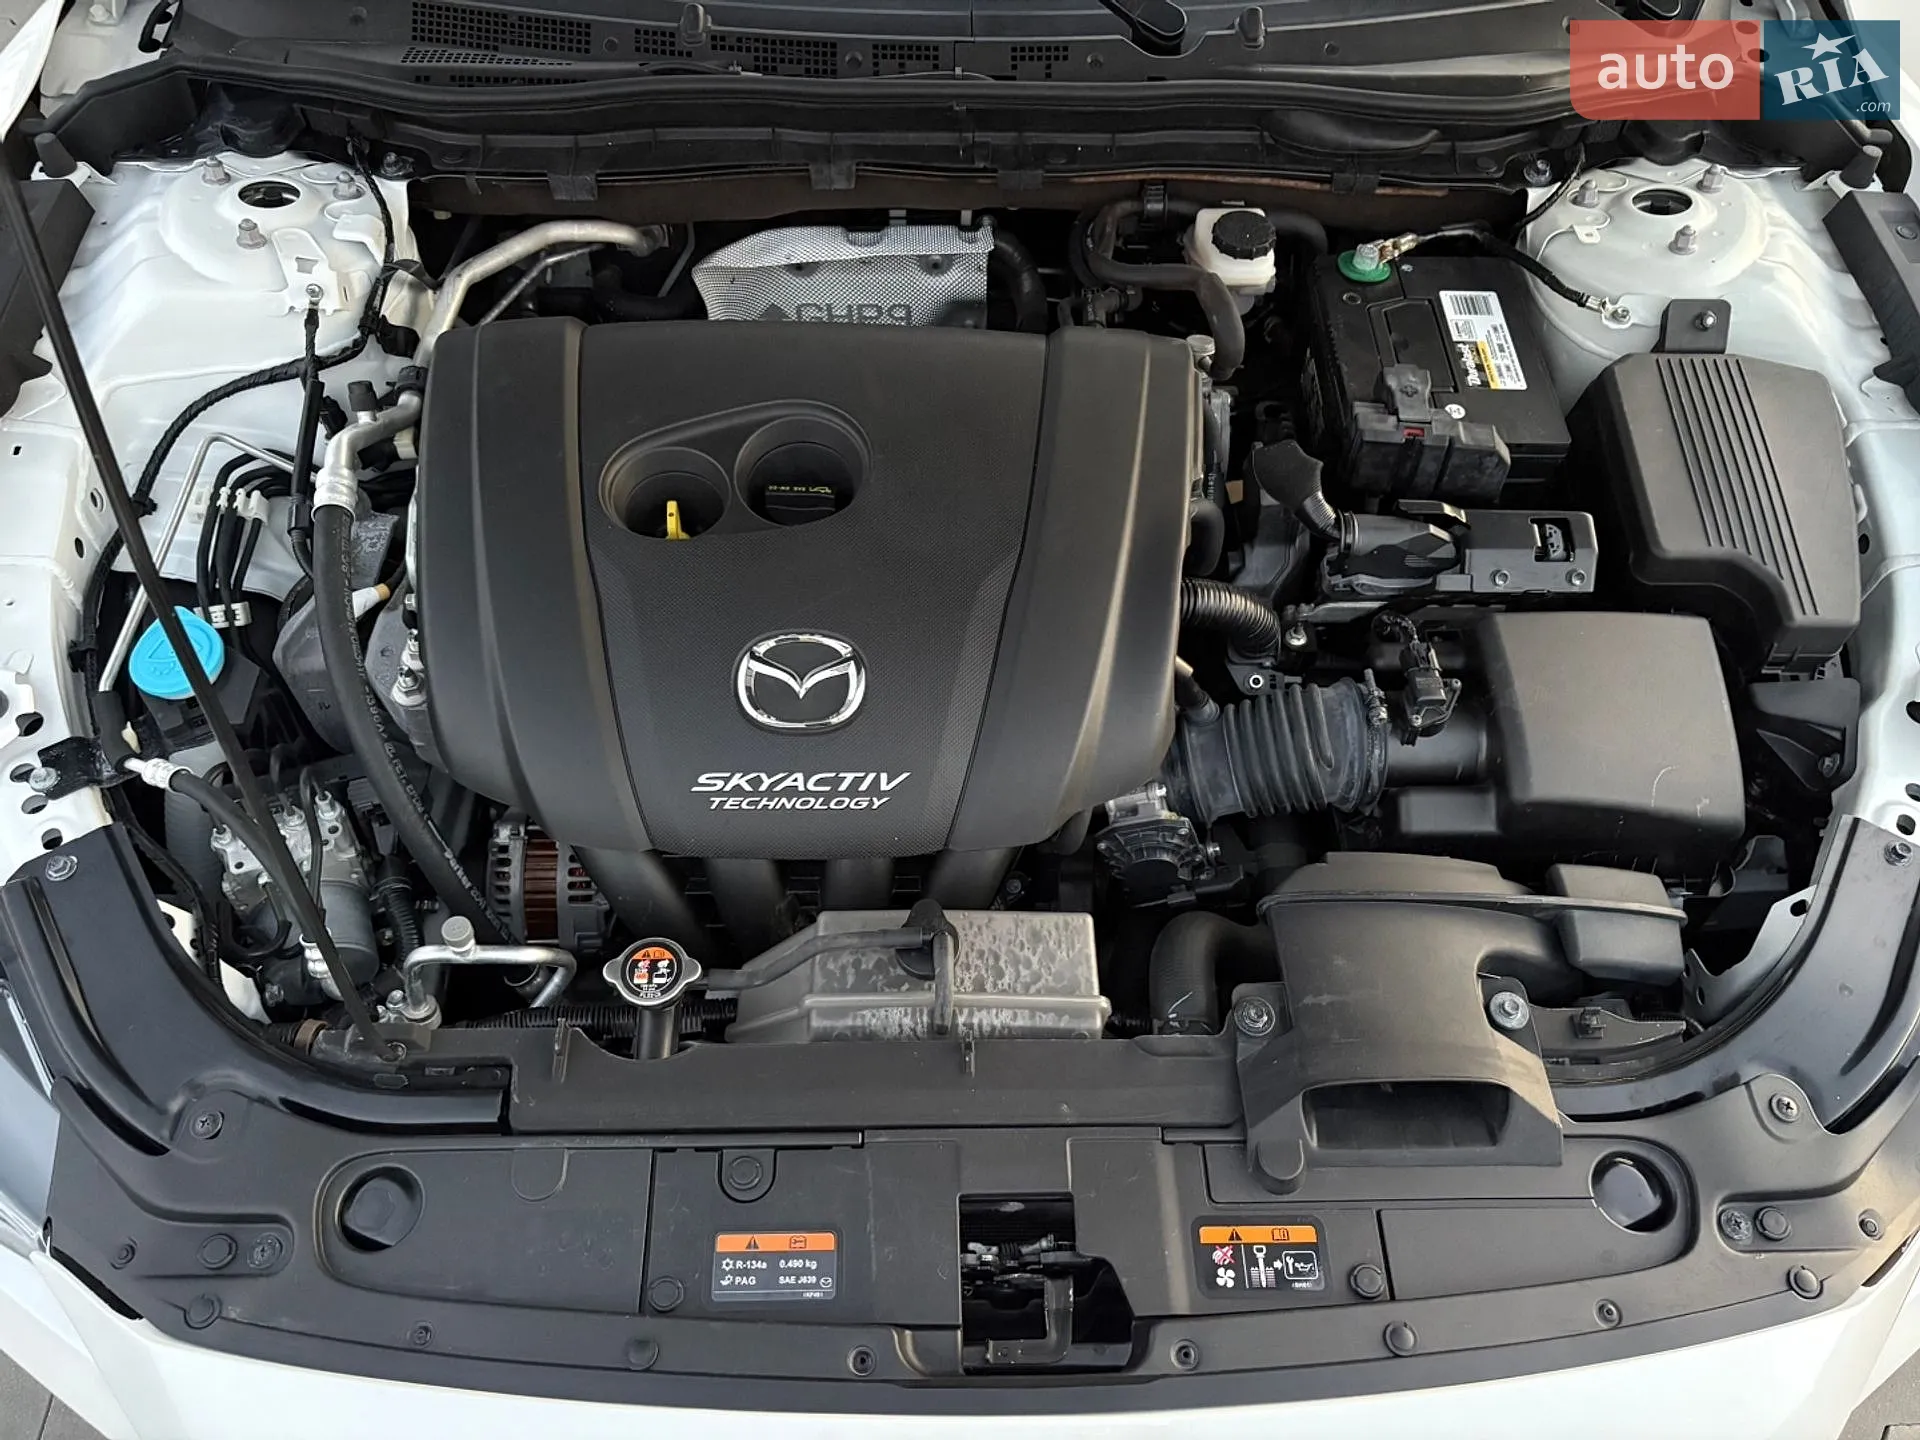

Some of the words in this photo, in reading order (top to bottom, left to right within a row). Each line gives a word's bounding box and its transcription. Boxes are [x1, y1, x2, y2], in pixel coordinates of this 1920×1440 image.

[690, 772, 912, 792] SKYACTIV
[709, 797, 890, 810] TECHNOLOGY
[735, 1260, 767, 1270] R-134a
[779, 1259, 803, 1269] 0.490
[805, 1259, 818, 1270] kg
[734, 1276, 756, 1286] PAG
[778, 1275, 796, 1284] SAE
